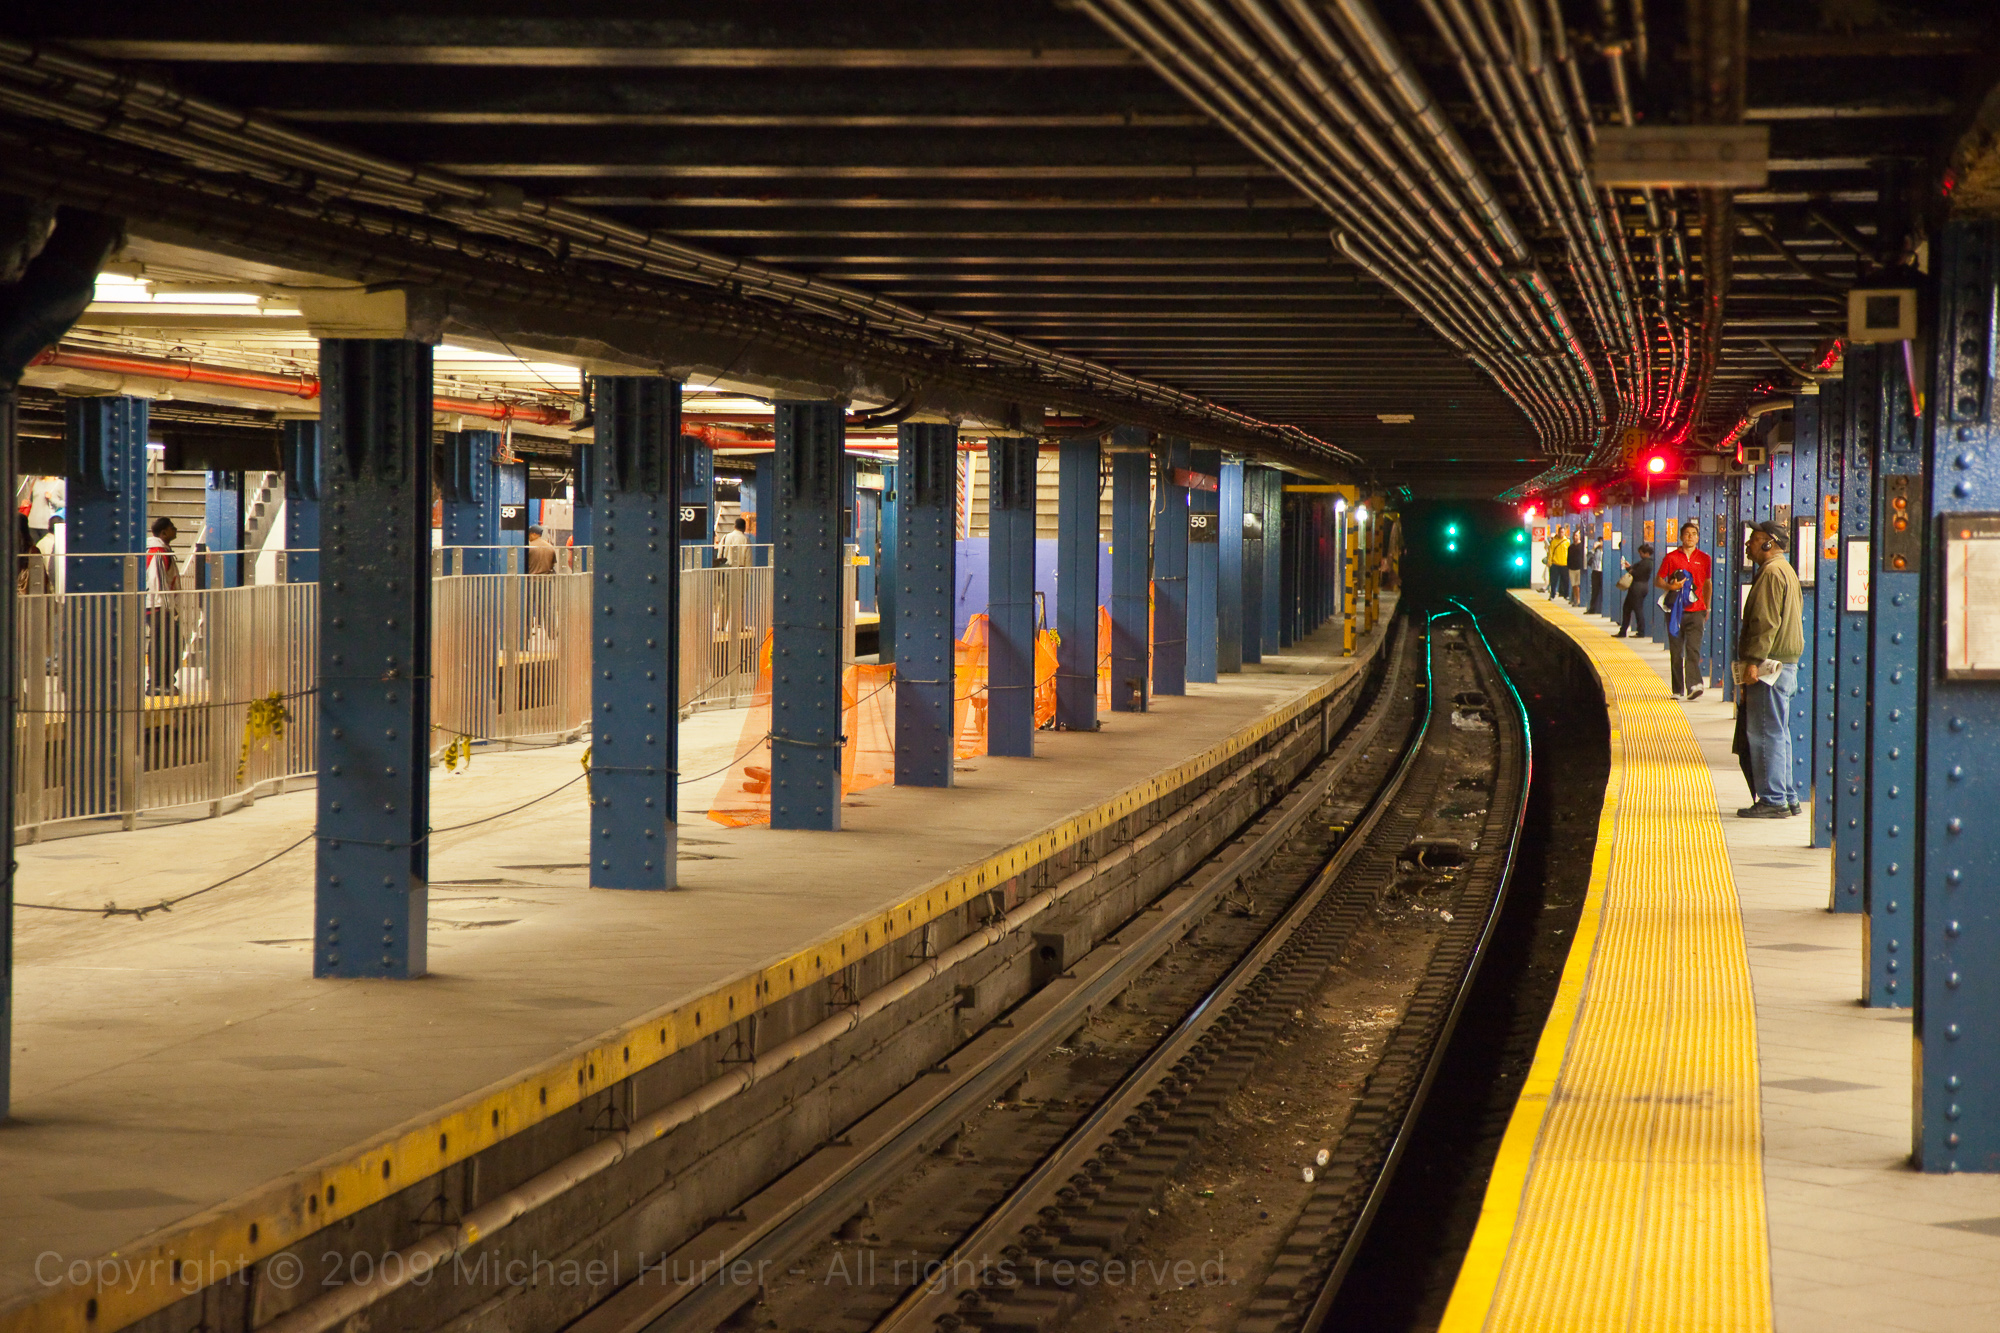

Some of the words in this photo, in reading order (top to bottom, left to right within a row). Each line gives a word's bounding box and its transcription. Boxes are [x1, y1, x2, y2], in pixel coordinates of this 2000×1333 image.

[501, 508, 516, 518] 59
[679, 508, 695, 522] 59
[1190, 516, 1207, 528] 59
